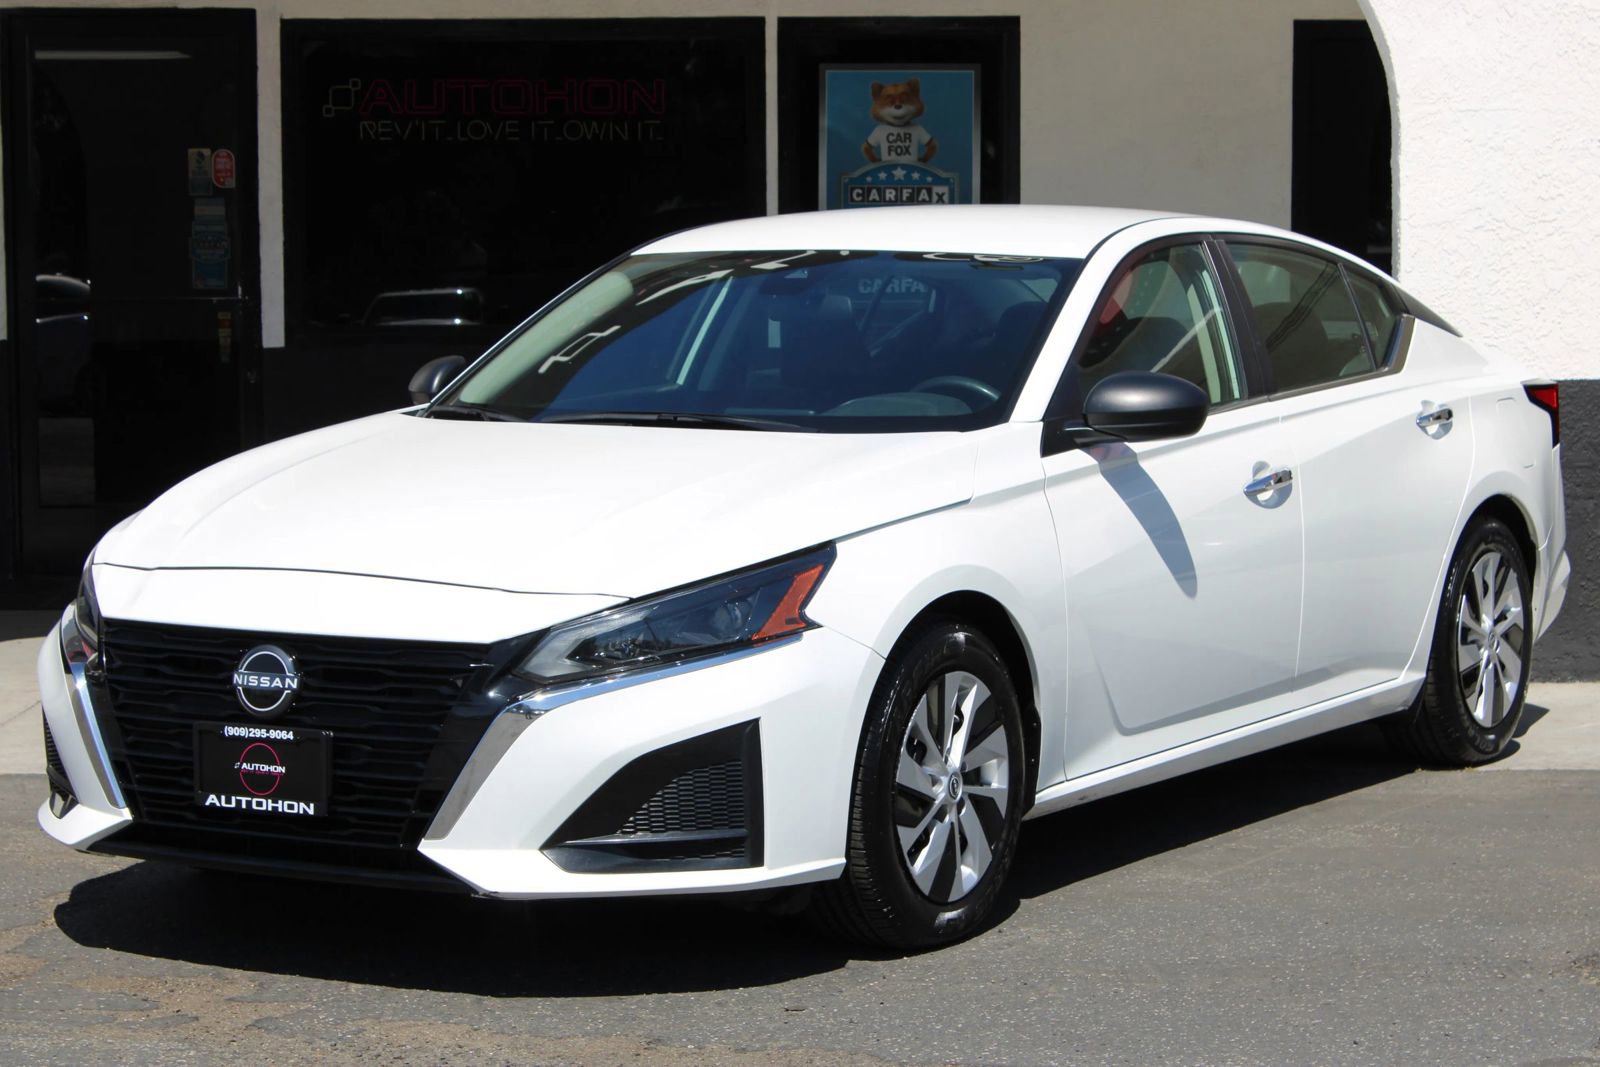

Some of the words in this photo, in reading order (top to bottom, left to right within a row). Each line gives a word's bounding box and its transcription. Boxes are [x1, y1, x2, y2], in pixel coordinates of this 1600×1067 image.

[358, 78, 667, 115] AUTOHON
[457, 119, 520, 141] LOVE
[886, 132, 912, 144] CAR
[888, 145, 912, 156] FOX
[851, 187, 947, 204] CARFAX
[233, 673, 298, 689] NISSAN
[224, 725, 294, 740] (909)295-9064
[241, 762, 286, 773] AUTOHON
[205, 793, 315, 815] AUTOHON
